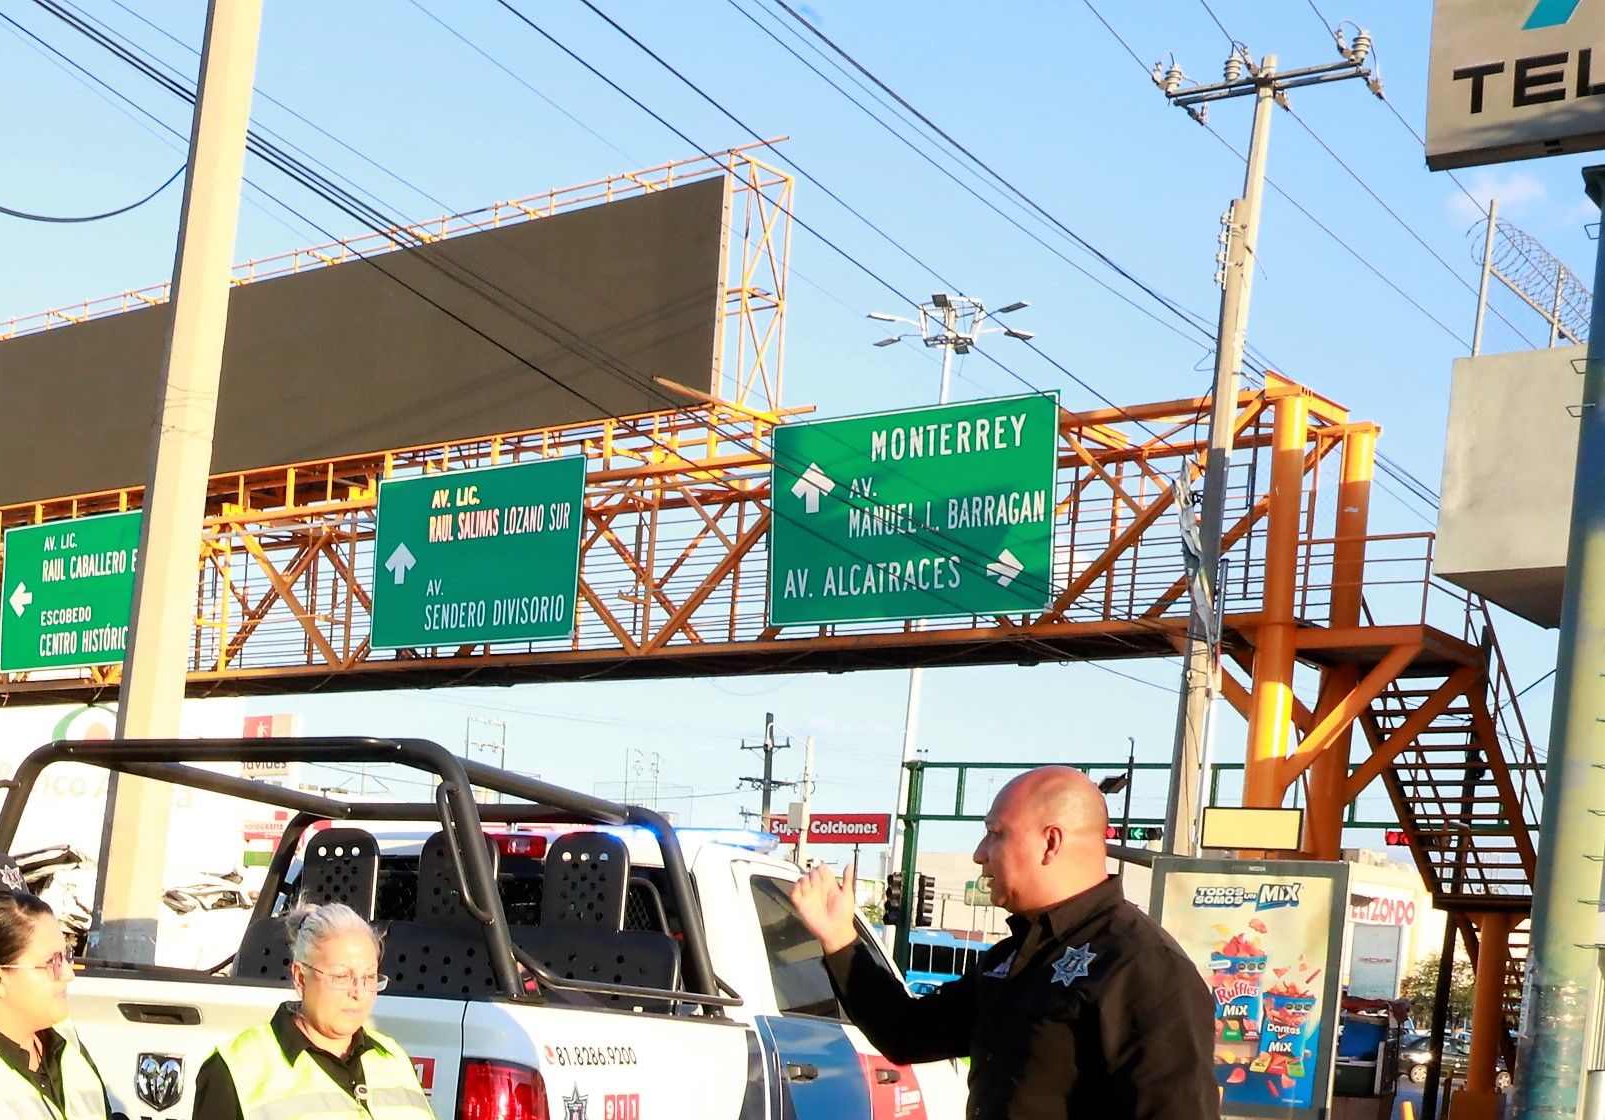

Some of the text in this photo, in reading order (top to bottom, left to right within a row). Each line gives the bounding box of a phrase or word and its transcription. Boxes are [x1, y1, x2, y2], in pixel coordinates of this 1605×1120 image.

[1452, 48, 1605, 114] TEL
[871, 413, 1027, 462] MONTERREY
[431, 486, 480, 509] AV. LIC.
[849, 477, 877, 498] AV.
[429, 502, 571, 543] RAUL SALINAS LOZANO SUR
[849, 502, 917, 538] MANUEL
[947, 490, 1046, 530] BARRAGAN
[43, 533, 77, 551] AV. LIC.
[42, 560, 66, 582] RAUL
[69, 550, 126, 579] CABALLERO
[784, 556, 961, 598] AV. ALCATRACES
[426, 579, 444, 596] AV.
[40, 606, 92, 626] ESCOBEDO
[424, 594, 564, 630] SENDERO DIVISORIO
[39, 623, 128, 656] CENTRO HISTÓRIC
[810, 820, 878, 835] Colchones
[1194, 896, 1244, 905] SOMOS
[1198, 886, 1245, 896] TODOS
[1215, 981, 1259, 1004] Ruffles
[1267, 1023, 1301, 1035] Doritos
[555, 1046, 637, 1066] 81.8286.9200
[605, 1099, 638, 1119] 911
